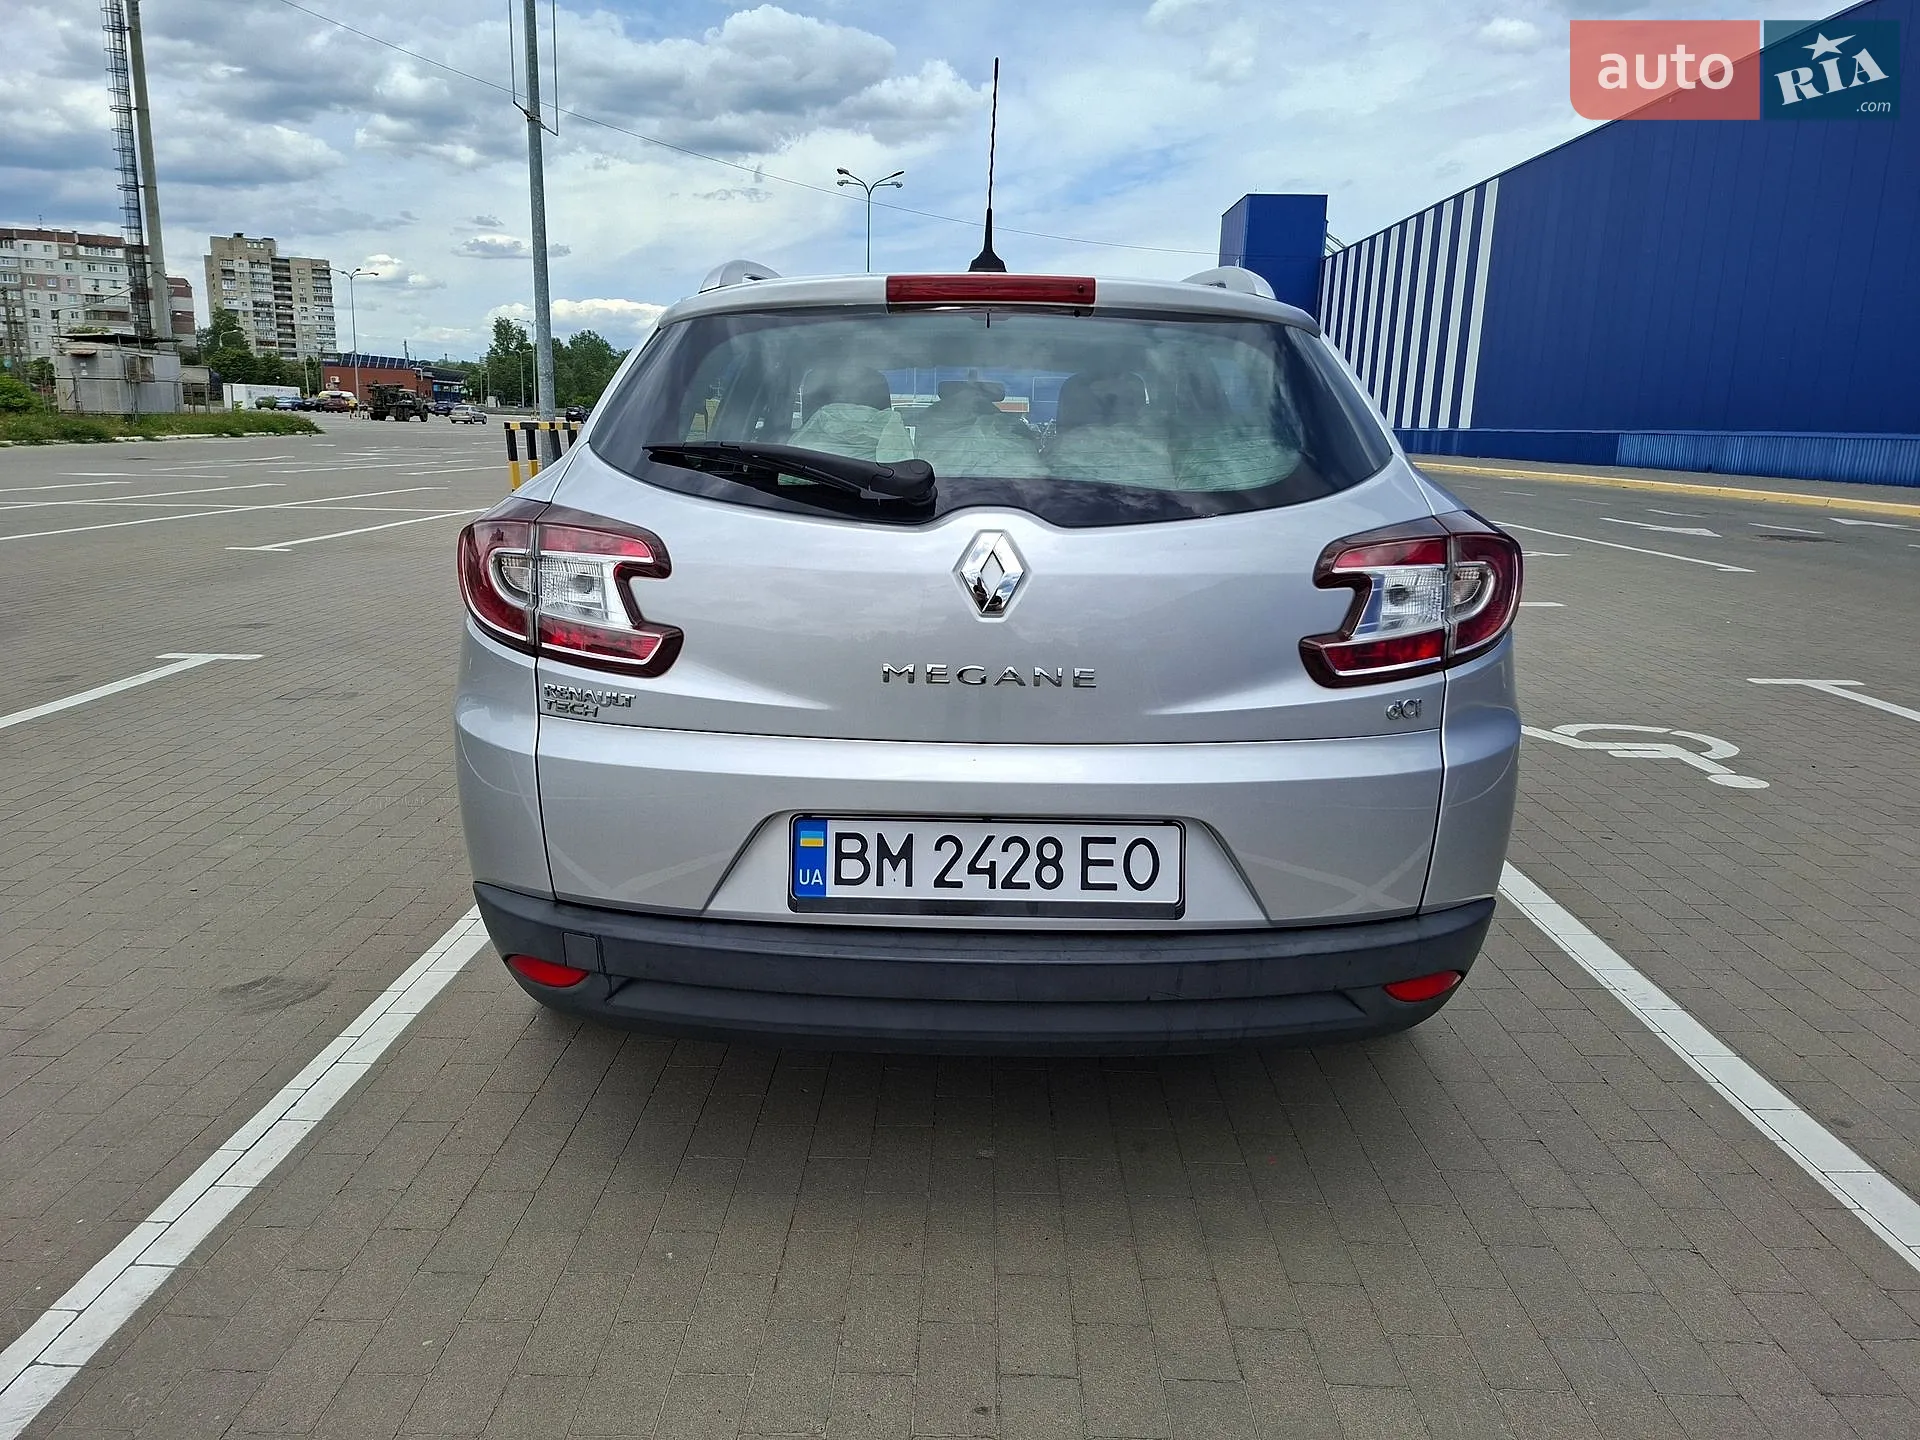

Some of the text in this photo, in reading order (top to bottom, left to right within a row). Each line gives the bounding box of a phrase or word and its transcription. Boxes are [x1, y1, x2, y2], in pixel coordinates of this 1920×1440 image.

[881, 662, 1098, 688] MEGANE
[543, 682, 637, 709] RENAULT
[543, 698, 599, 718] TECH
[833, 831, 914, 888] BM
[933, 834, 1064, 891] 2428
[799, 868, 824, 886] UA
